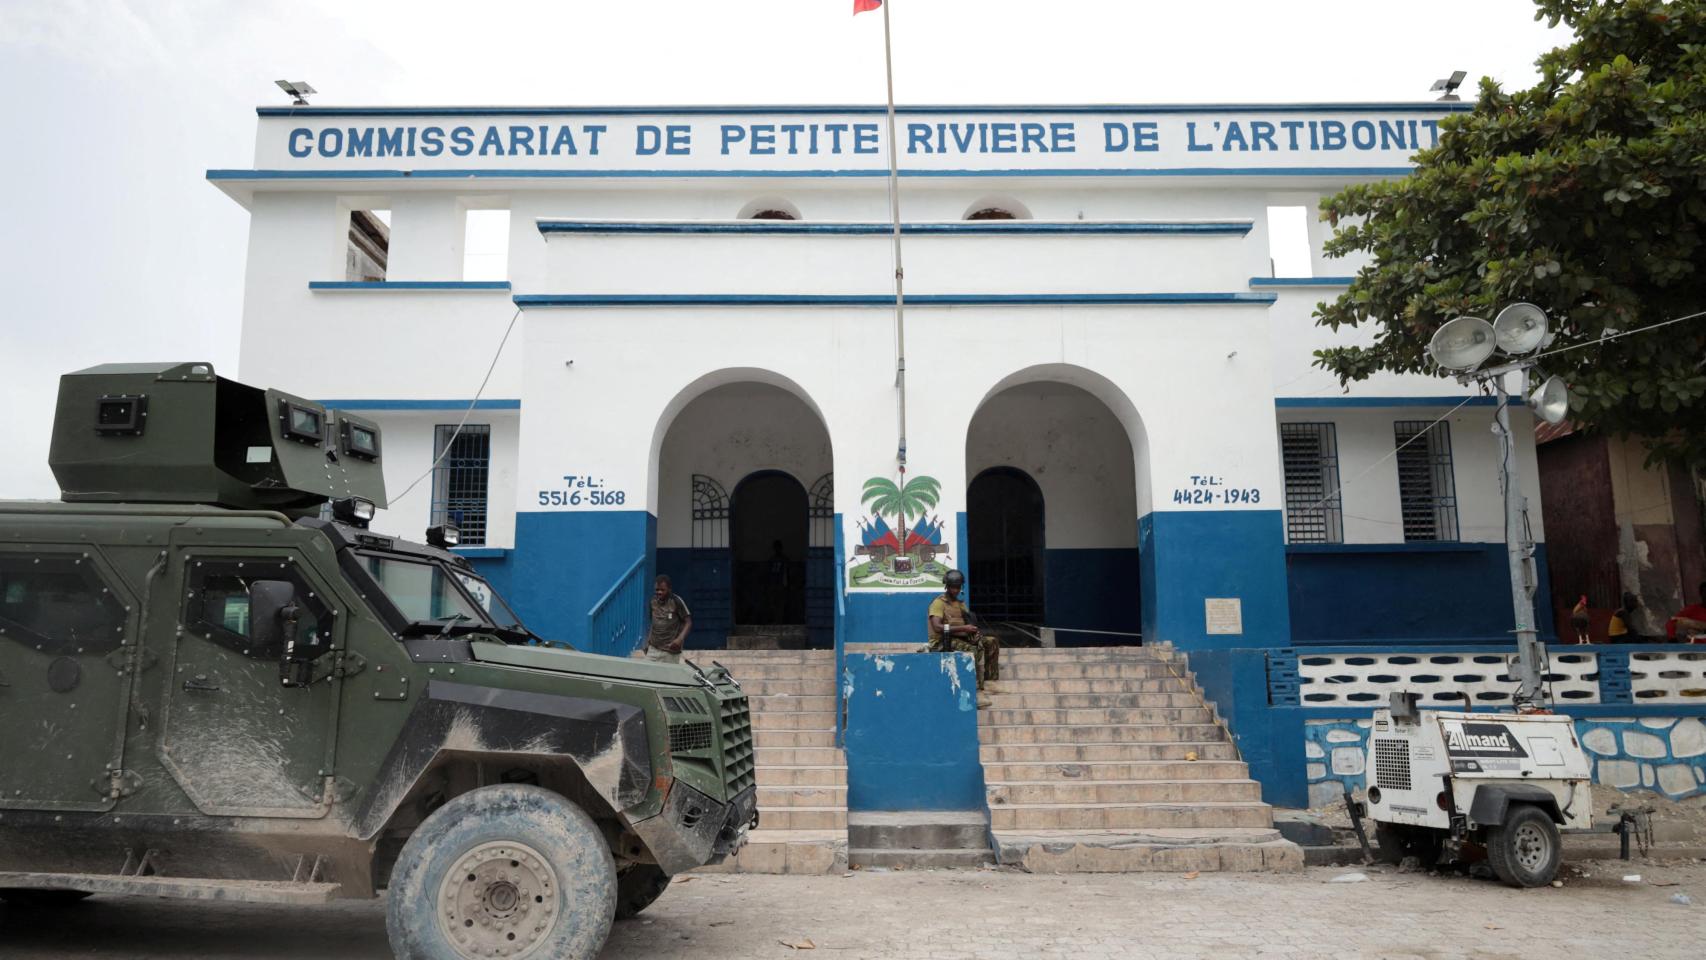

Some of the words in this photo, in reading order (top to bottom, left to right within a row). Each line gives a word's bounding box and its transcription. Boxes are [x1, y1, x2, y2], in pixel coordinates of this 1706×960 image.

[288, 124, 609, 159] COMMISSARIAT
[635, 125, 692, 156] DE
[719, 123, 881, 156] PETITE
[906, 122, 1075, 155] RIVIERE
[1103, 122, 1159, 154] DE
[1186, 119, 1438, 153] L'ARTIBONIT
[538, 490, 626, 506] 5516-5168
[1173, 488, 1261, 504] 4424-1943
[1448, 730, 1510, 751] Allmand
